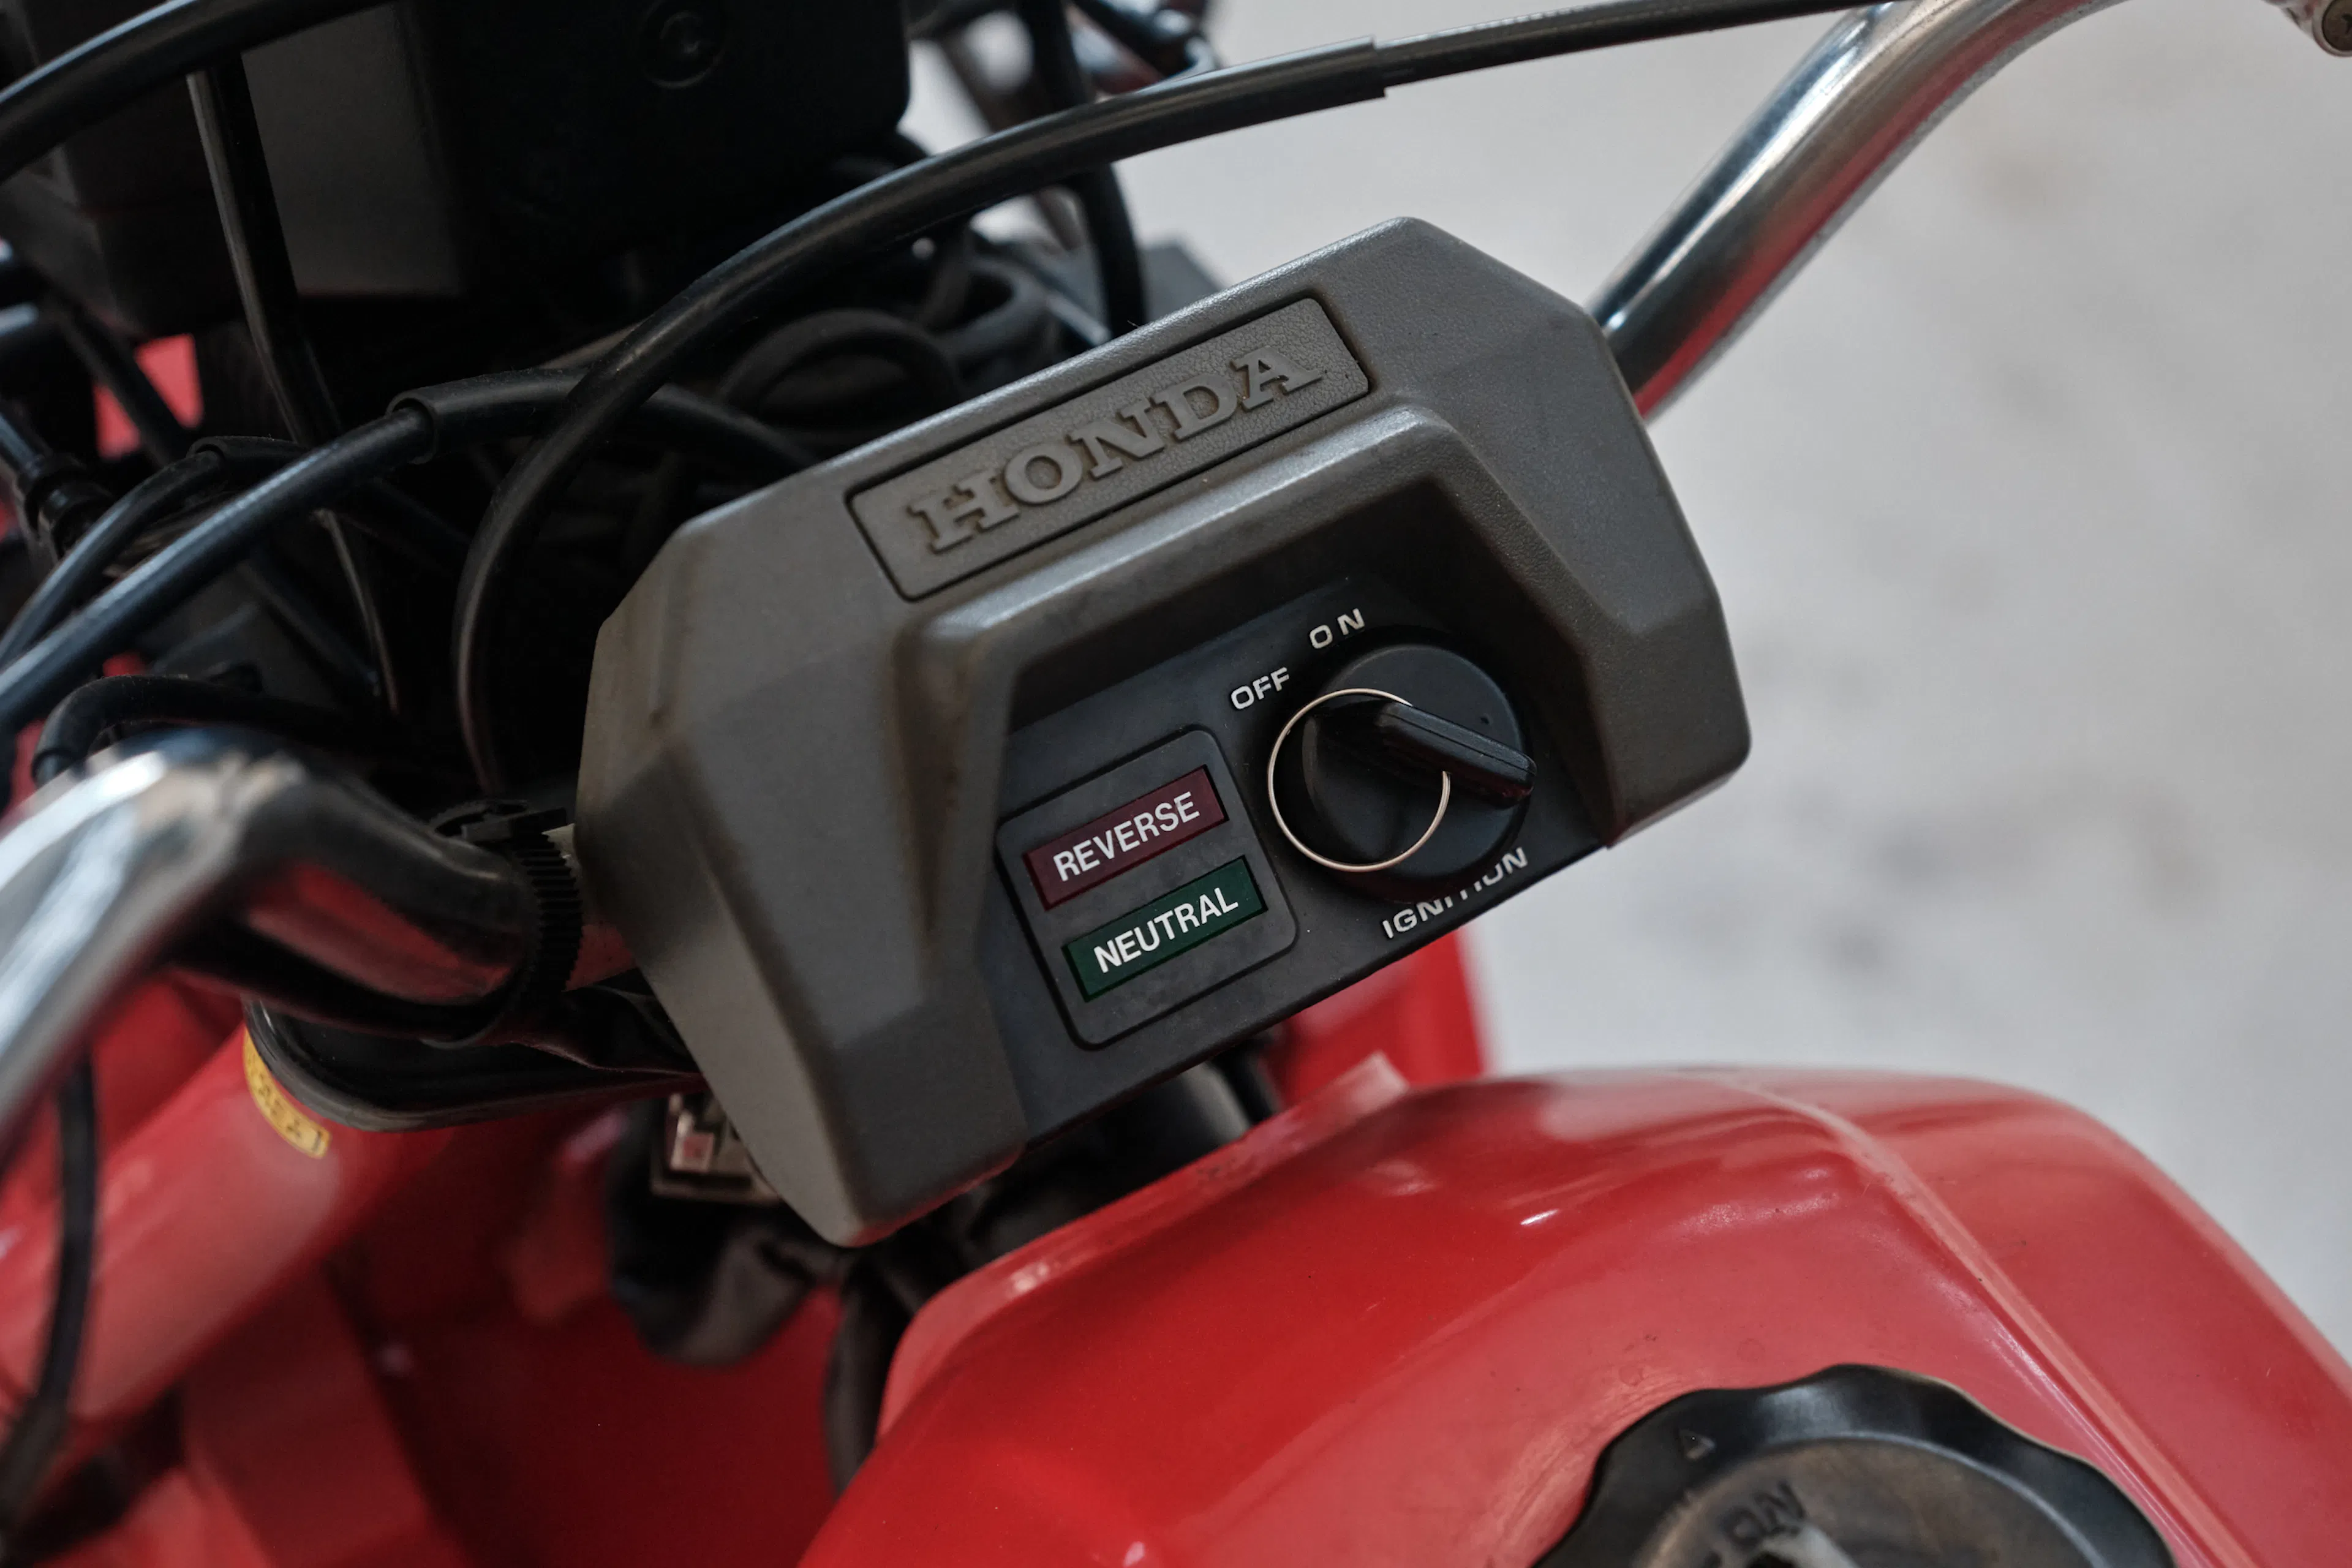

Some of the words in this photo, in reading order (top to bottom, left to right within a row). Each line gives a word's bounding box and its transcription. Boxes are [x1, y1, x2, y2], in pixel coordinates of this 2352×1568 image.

[908, 347, 1327, 554] HONDA
[1309, 608, 1365, 650] ON
[1230, 667, 1290, 710] OFF
[1052, 791, 1200, 882] REVERSE
[1093, 886, 1239, 974] NEUTRAL
